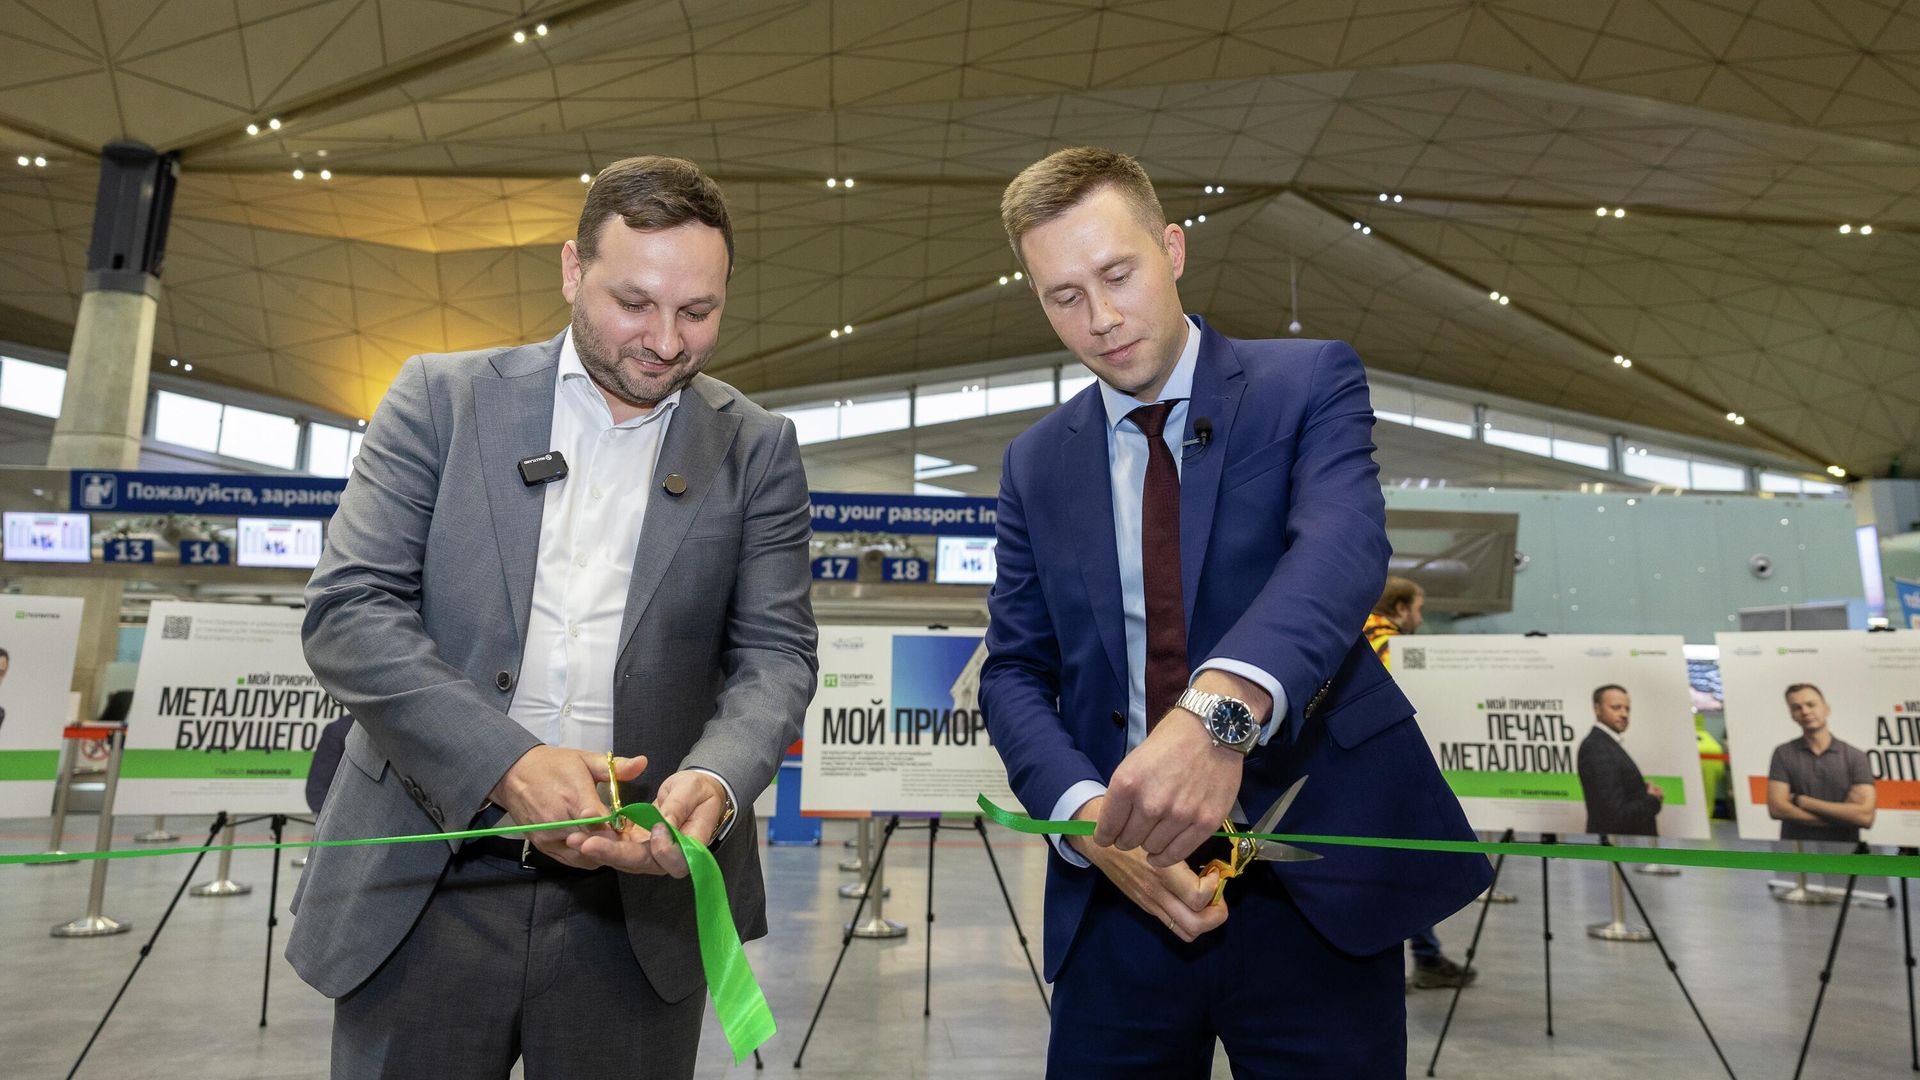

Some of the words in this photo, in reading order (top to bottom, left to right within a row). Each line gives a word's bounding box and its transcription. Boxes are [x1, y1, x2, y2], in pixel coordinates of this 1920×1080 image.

[127, 481, 258, 506] Пожалуйста,
[839, 505, 886, 524] your
[888, 505, 976, 526] passport
[114, 541, 145, 561] 13
[190, 542, 221, 563] 14
[821, 559, 850, 579] 17
[891, 560, 920, 580] 18
[247, 672, 271, 685] МОЙ
[158, 686, 344, 719] МЕТАЛЛУРГИЯ
[822, 698, 886, 745] МОЙ
[895, 708, 993, 746] ПРИОР
[1487, 713, 1574, 742] ПЕЧАТЬ
[176, 719, 317, 754] БУДУЩЕГО
[1440, 742, 1573, 773] МЕТАЛЛОМ
